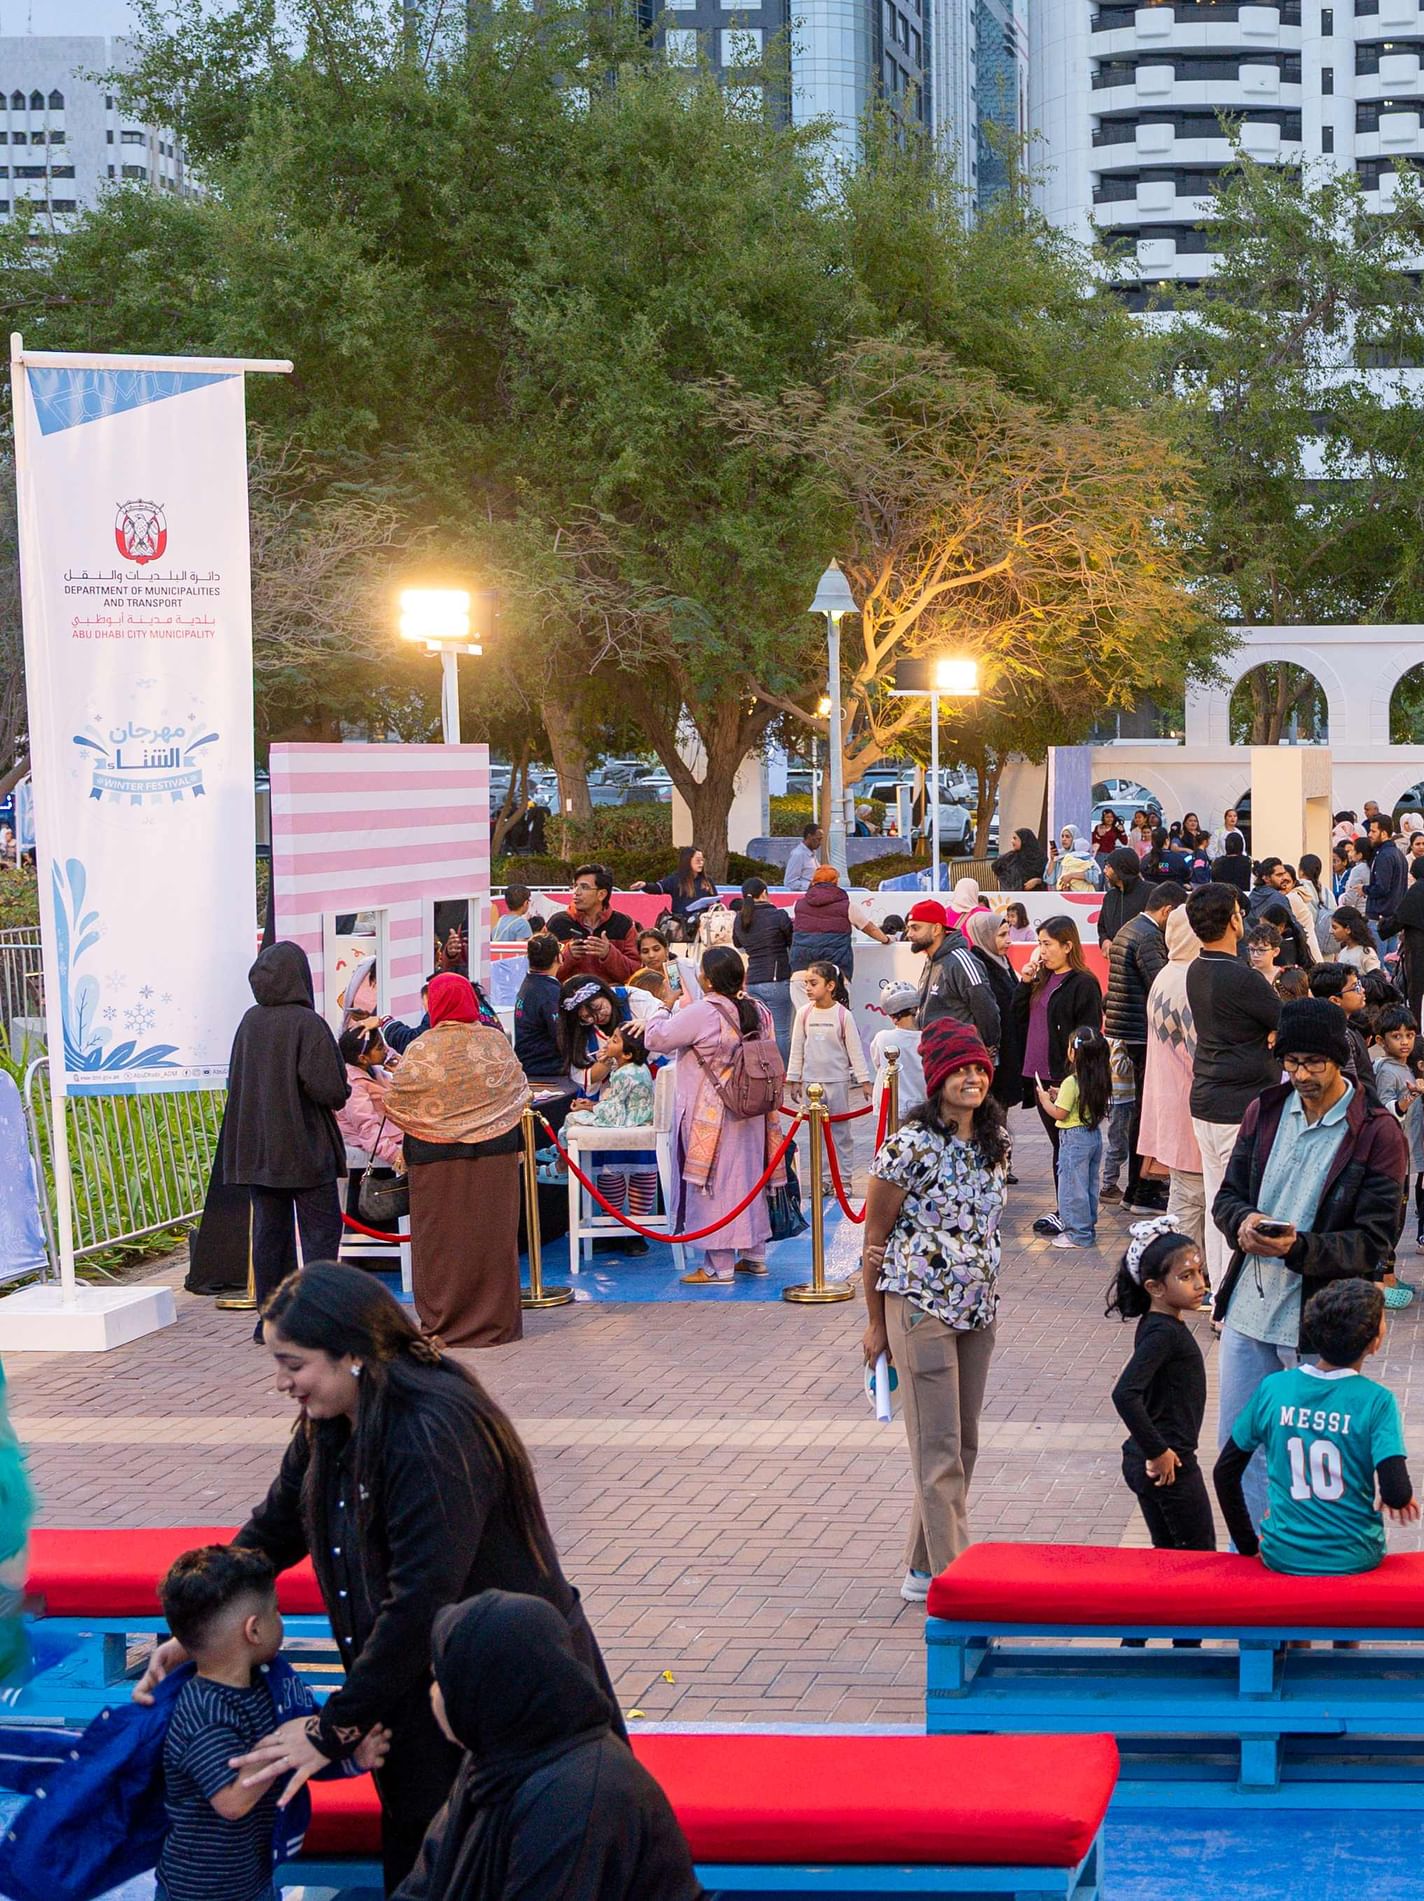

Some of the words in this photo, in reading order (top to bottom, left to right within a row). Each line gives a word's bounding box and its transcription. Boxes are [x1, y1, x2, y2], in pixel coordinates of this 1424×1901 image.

[63, 569, 123, 584] والنقل
[125, 569, 187, 583] البلديات
[189, 570, 221, 584] دائرة
[64, 585, 128, 595] DEPARTMENT
[131, 586, 143, 595] OF
[145, 586, 221, 596] MUNICIPALITIES
[103, 598, 125, 607] AND
[127, 598, 183, 608] TRANSPORT
[72, 630, 92, 639] ABU
[94, 630, 125, 639] DHABI
[127, 630, 147, 639] CITY
[149, 629, 216, 639] MUNICIPALITY
[109, 721, 186, 744] مهرجان
[107, 747, 180, 770] الشتاء
[103, 778, 147, 792] WINTER
[147, 775, 191, 791] FESTIVAL
[1279, 1405, 1352, 1434] MESSI
[1287, 1436, 1346, 1501] 10
